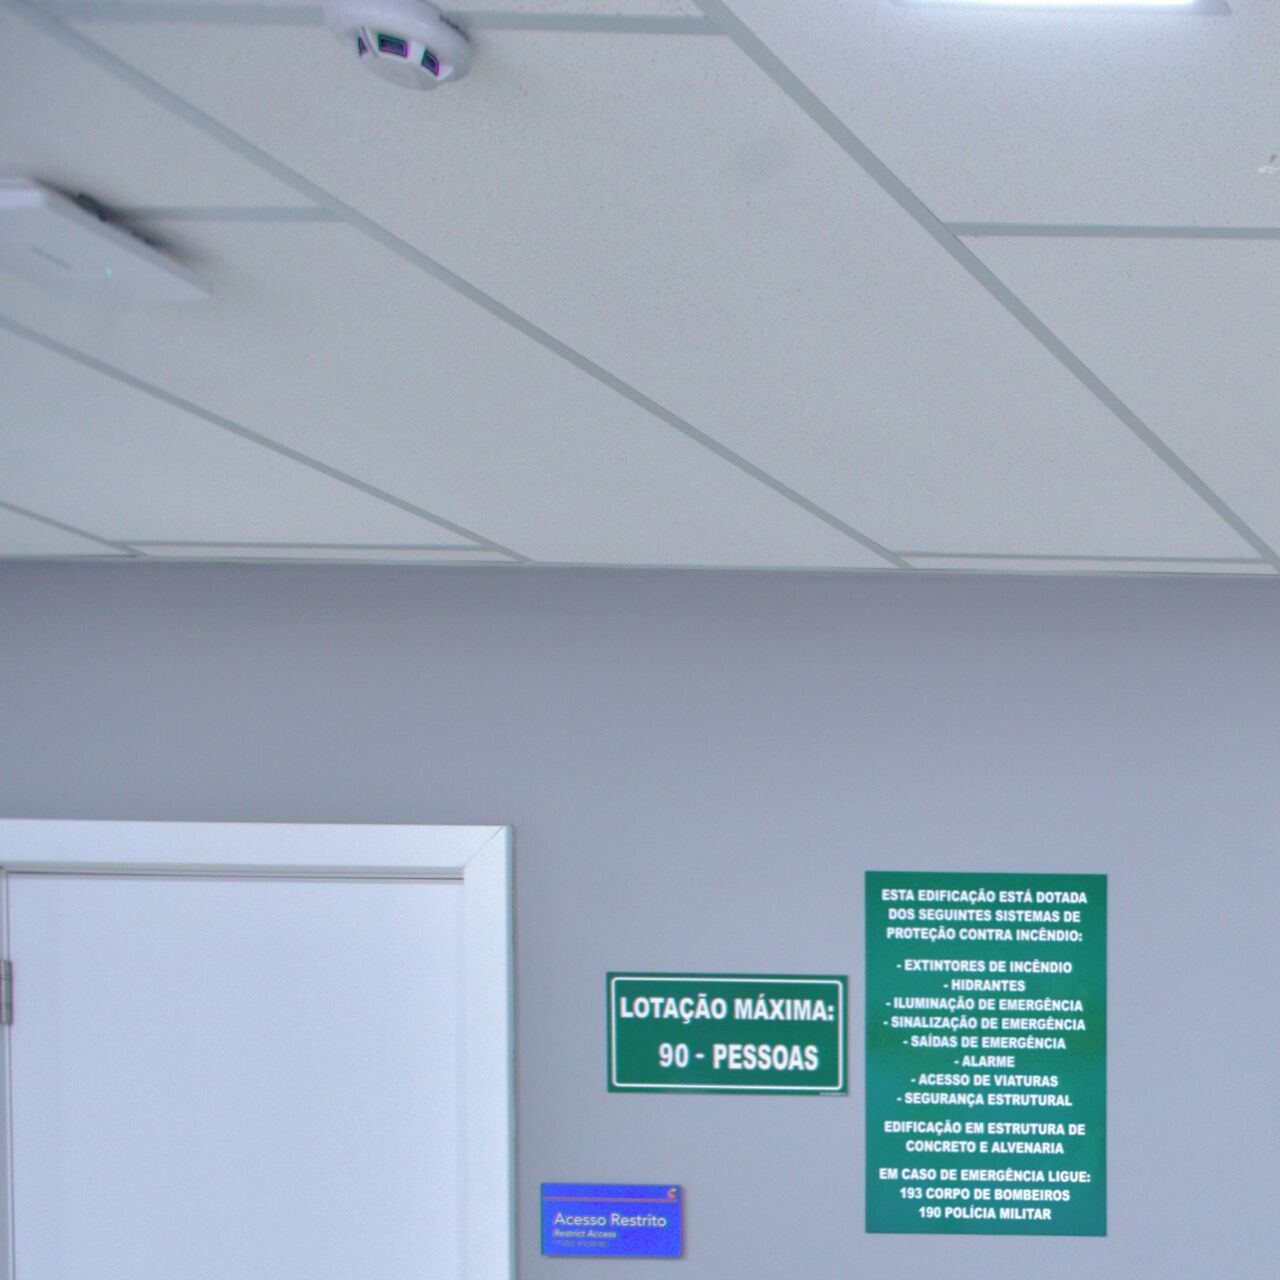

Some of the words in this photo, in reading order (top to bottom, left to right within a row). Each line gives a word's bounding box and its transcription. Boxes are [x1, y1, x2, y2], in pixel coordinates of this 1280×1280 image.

[881, 888, 915, 902] ESTA
[917, 887, 996, 905] EDIFICAÇÃO
[998, 888, 1033, 903] ESTÁ
[1035, 891, 1087, 904] DOTADA
[887, 907, 915, 921] DOS
[918, 908, 992, 921] SEGUINTES
[994, 909, 1060, 922] SISTEMAS
[1063, 910, 1080, 923] DE
[886, 924, 956, 942] PROTEÇÃO
[958, 927, 1013, 941] CONTRA
[1015, 926, 1083, 943] INCÊNDIO:
[903, 958, 986, 972] EXTINTORES
[988, 959, 1006, 973] DE
[1009, 958, 1072, 974] INCÊNDIO
[950, 978, 1026, 992] HIDRANTES
[619, 991, 727, 1026] LOTAÇÃO
[733, 992, 834, 1021] MÁXIMA:
[893, 994, 975, 1012] ILUMINAÇÃO
[977, 997, 995, 1011] DE
[998, 997, 1083, 1012] EMERGÊNCIA
[890, 1013, 977, 1032] SINALIZAÇÃO
[980, 1016, 998, 1030] DE
[1001, 1015, 1086, 1031] EMERGÊNCIA
[910, 1033, 958, 1048] SAÍDAS
[960, 1035, 978, 1048] DE
[981, 1034, 1066, 1049] EMERGÊNCIA
[658, 1042, 689, 1068] 90
[712, 1042, 818, 1071] PESSOAS
[961, 1054, 1015, 1068] ALARME
[918, 1073, 970, 1086] ACESSO
[972, 1073, 991, 1086] DE
[993, 1074, 1059, 1087] VIATURAS
[904, 1091, 984, 1108] SEGURANÇA
[986, 1092, 1073, 1106] ESTRUTURAL
[883, 1120, 962, 1137] EDIFICAÇÃO
[964, 1121, 984, 1134] EM
[987, 1121, 1065, 1135] ESTRUTURA
[1067, 1122, 1086, 1136] DE
[905, 1139, 976, 1153] CONCRETO
[979, 1140, 988, 1153] E
[990, 1140, 1064, 1154] ALVENARIA
[878, 1167, 898, 1180] EM
[900, 1167, 937, 1181] CASO
[939, 1168, 957, 1181] DE
[960, 1166, 1045, 1183] EMERGÊNCIA
[1047, 1169, 1091, 1184] LIGUE:
[899, 1186, 923, 1200] 193
[925, 1187, 971, 1200] CORPO
[973, 1187, 991, 1200] DE
[993, 1188, 1071, 1202] BOMBEIROS
[553, 1212, 607, 1226] Acesso
[610, 1212, 667, 1227] Restrito
[918, 1206, 942, 1219] 190
[944, 1205, 996, 1220] POLÍCIA
[998, 1207, 1052, 1220] MILITAR
